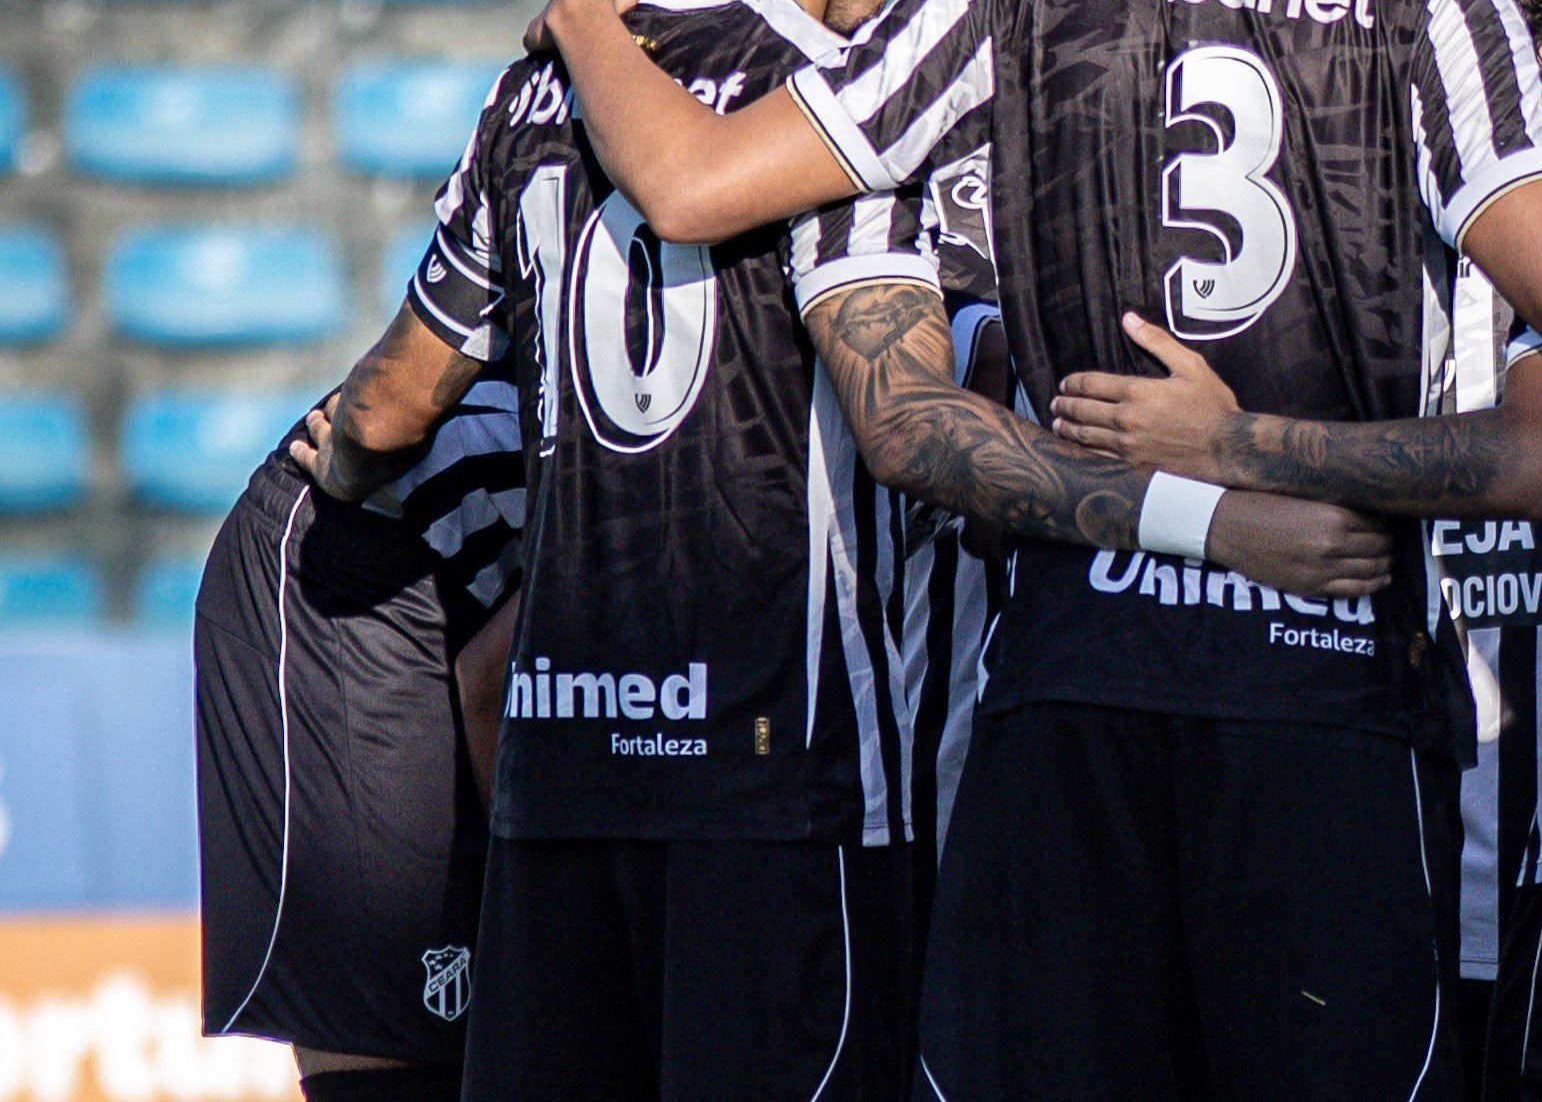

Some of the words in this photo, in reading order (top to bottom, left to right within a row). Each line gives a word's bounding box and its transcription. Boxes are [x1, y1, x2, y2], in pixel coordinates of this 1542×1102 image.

[1161, 45, 1299, 340] 3
[516, 164, 720, 457] 10
[504, 656, 708, 721] nimed
[611, 732, 708, 756] Fortaleza
